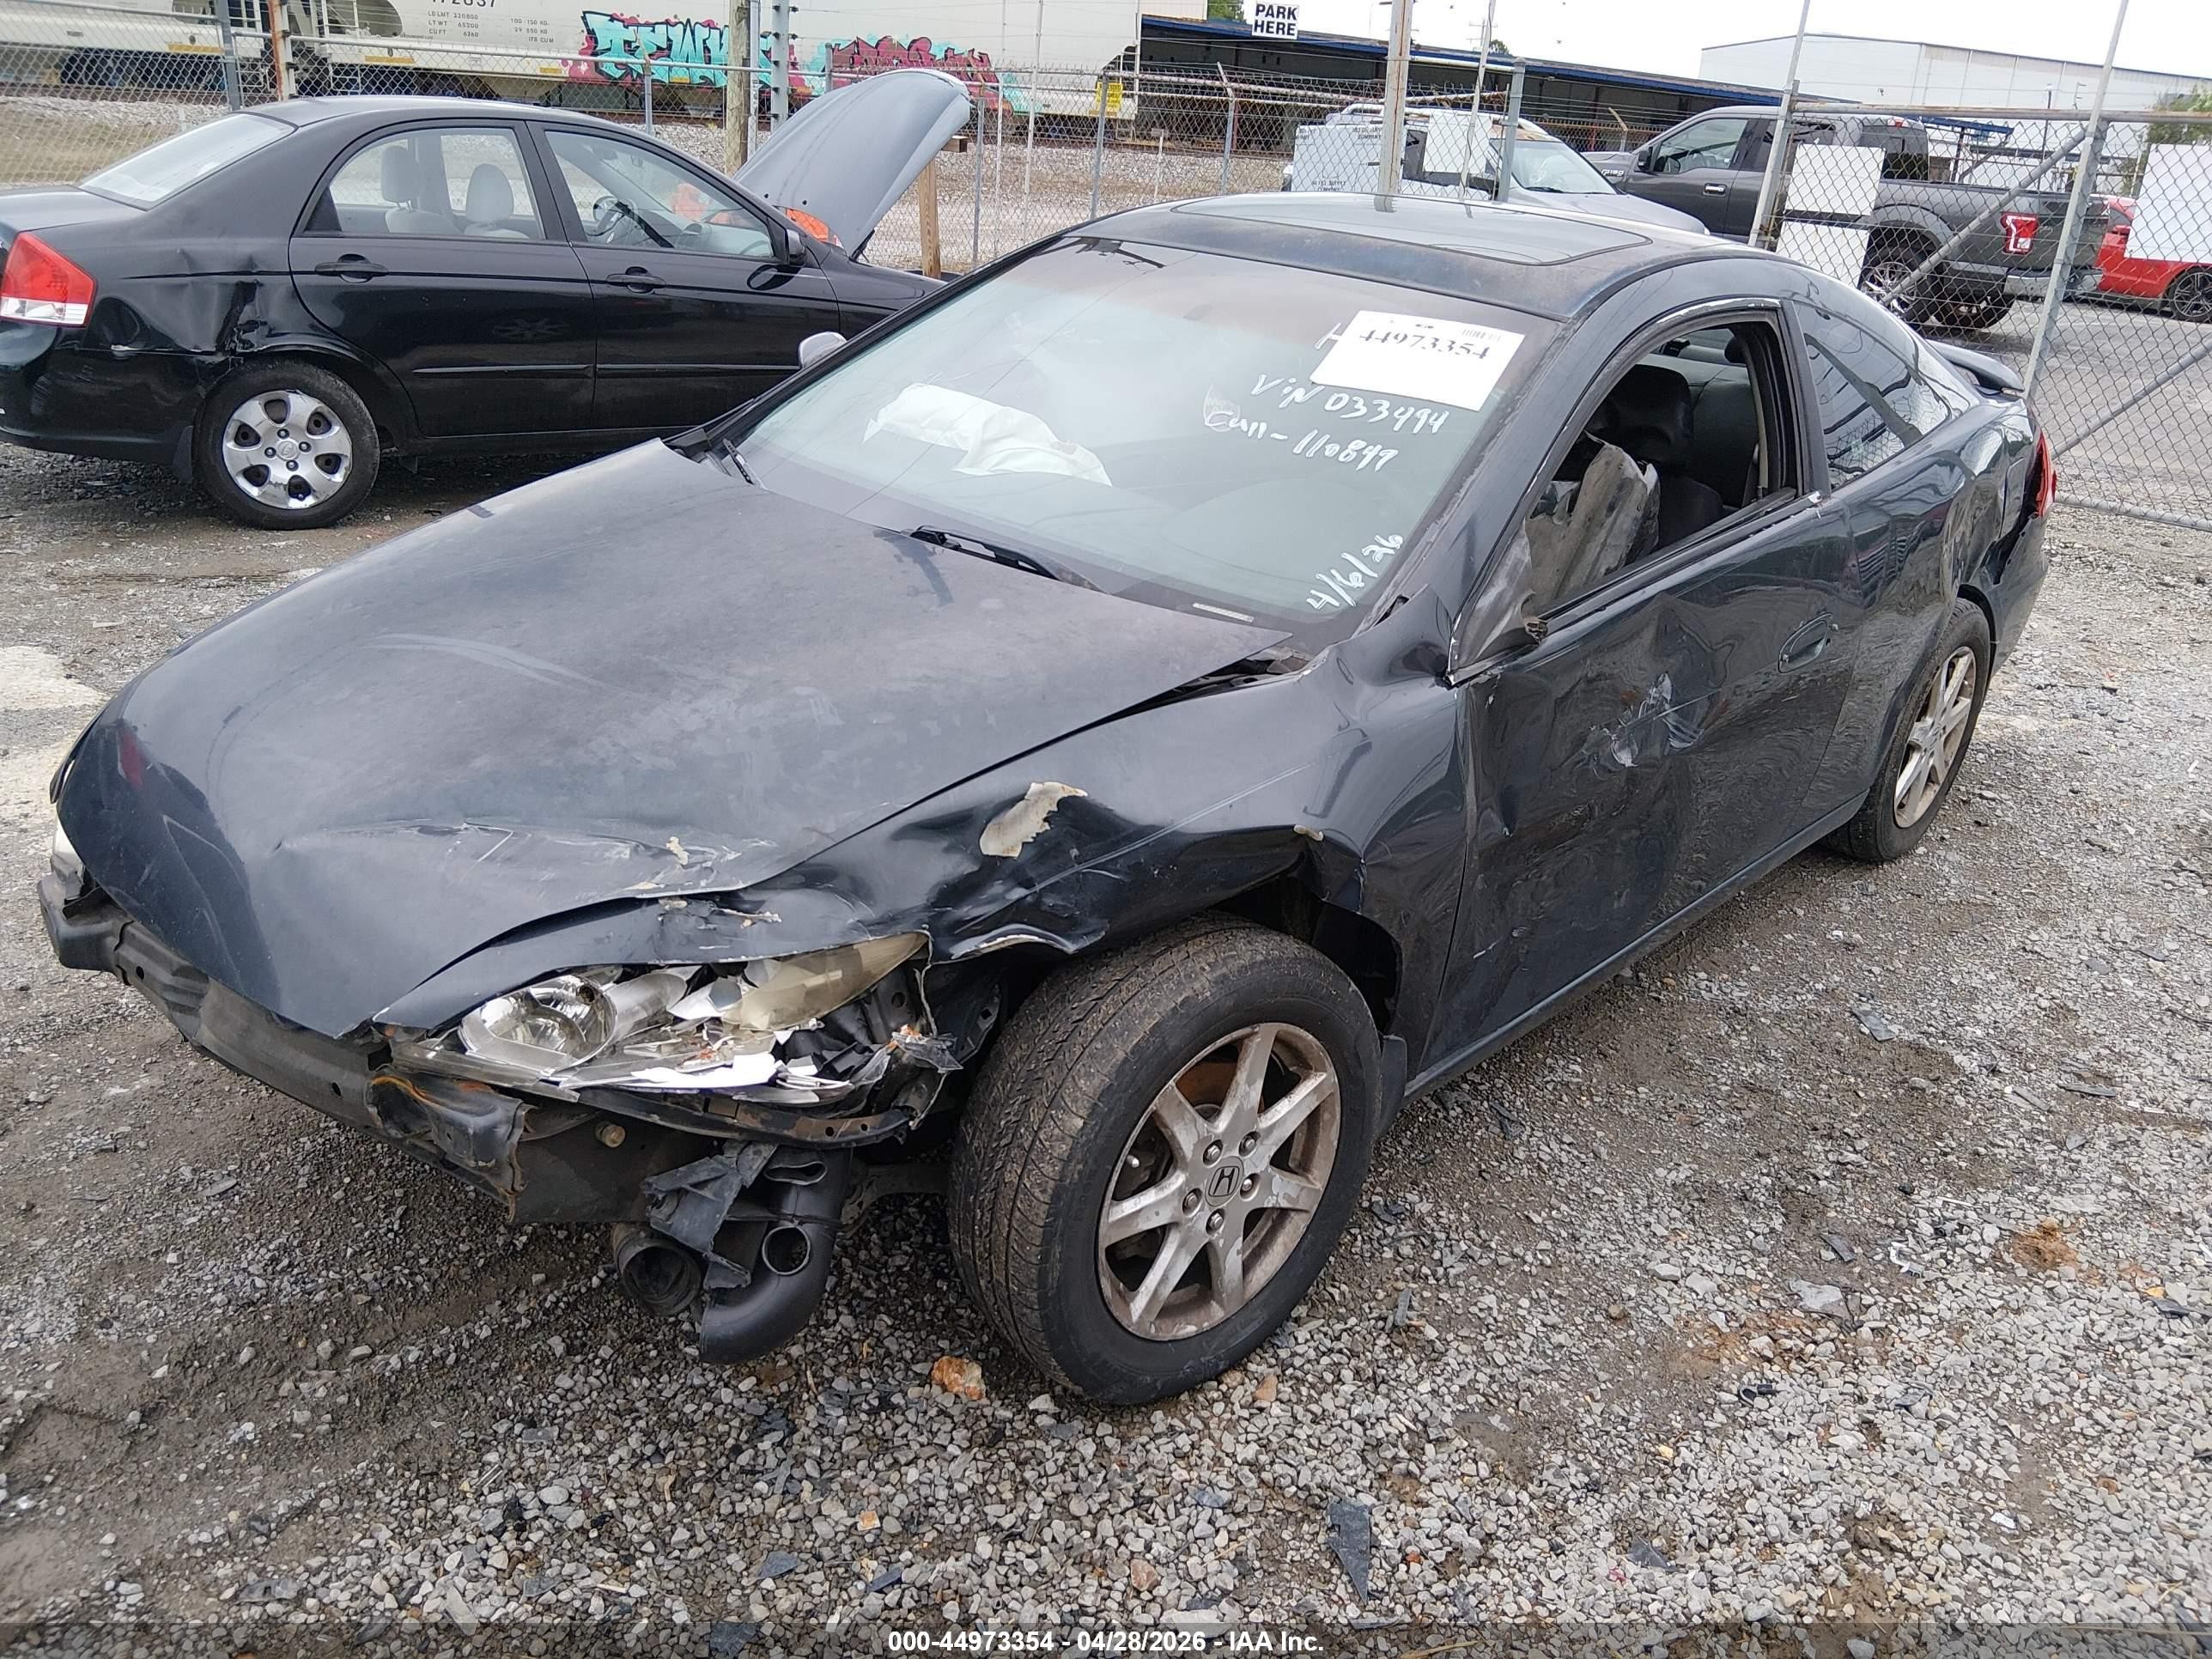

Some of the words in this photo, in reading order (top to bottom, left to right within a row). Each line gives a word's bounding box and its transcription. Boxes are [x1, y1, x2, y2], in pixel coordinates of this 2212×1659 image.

[1255, 3, 1297, 21] PARK
[1254, 19, 1297, 36] HERE
[1359, 330, 1491, 360] 44973354
